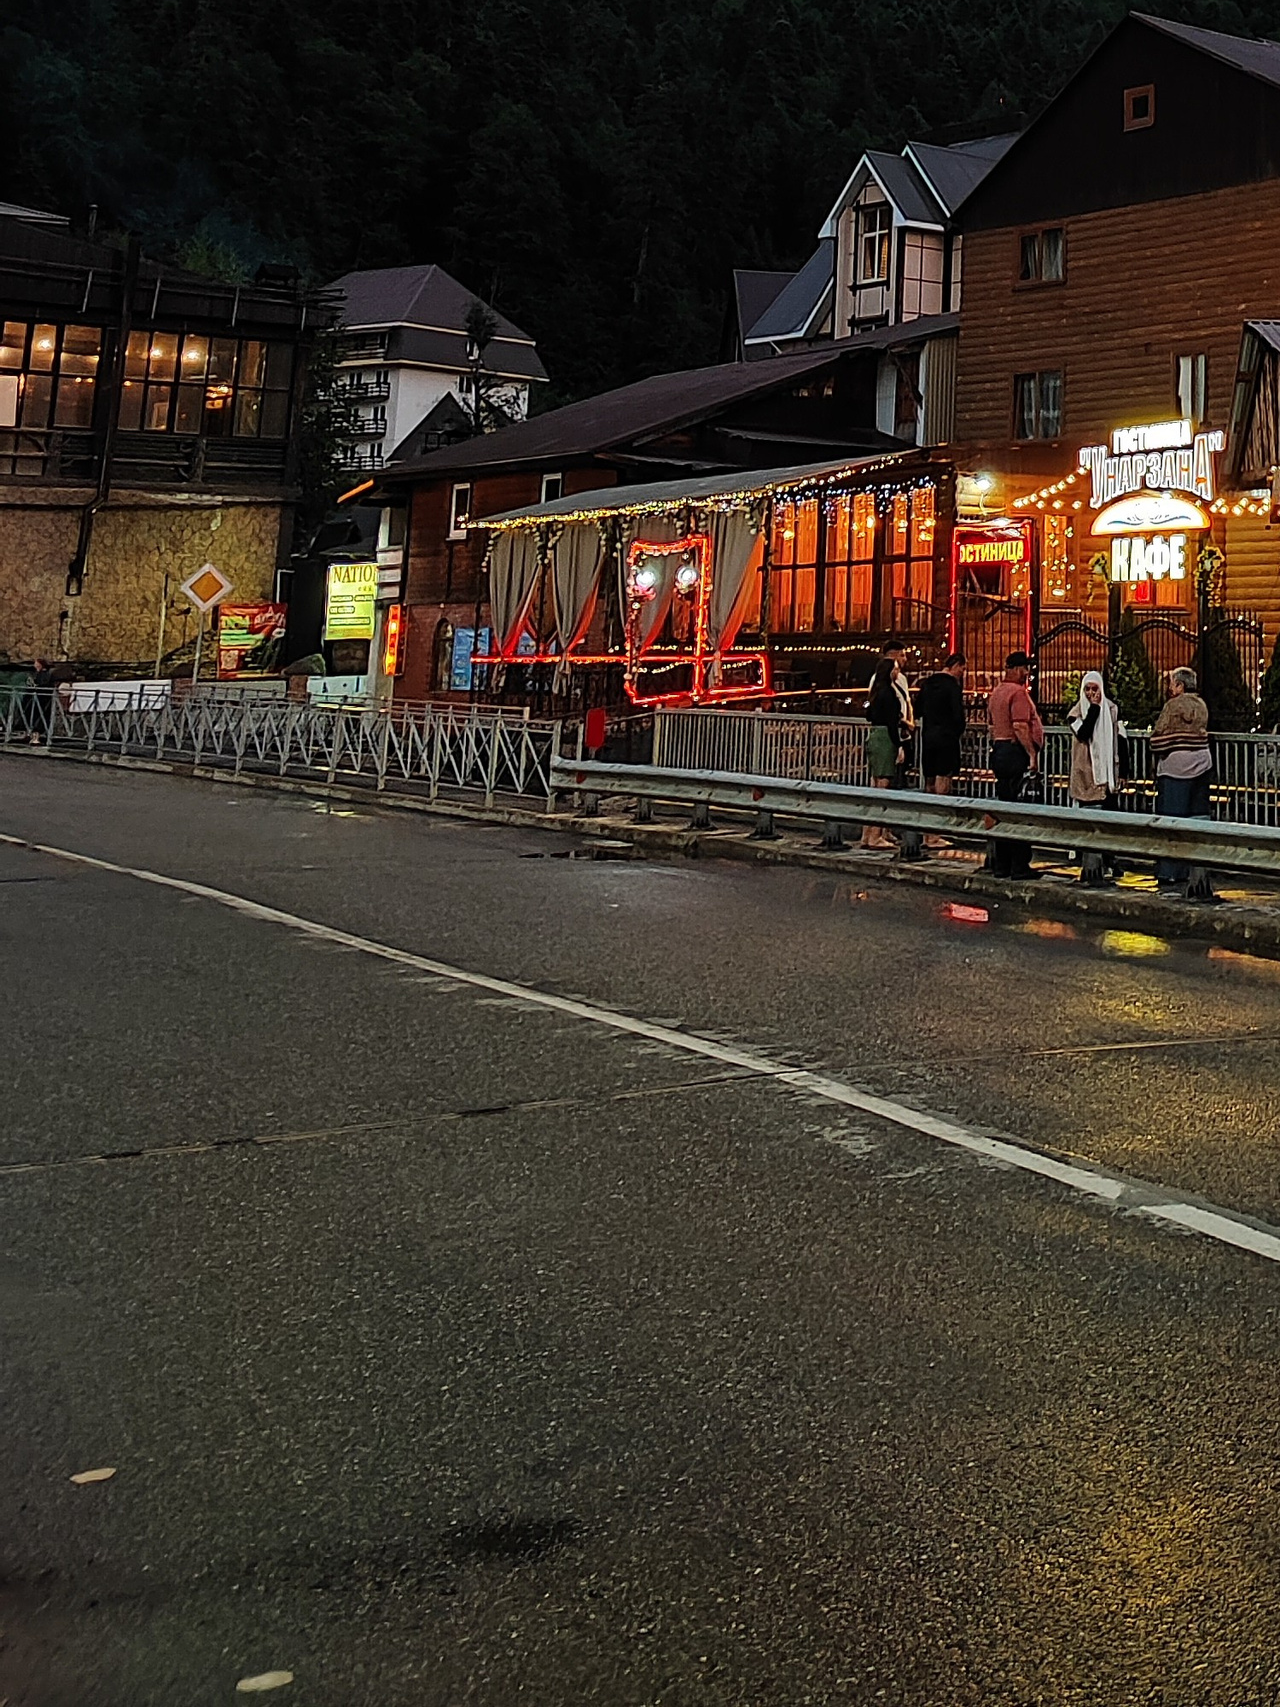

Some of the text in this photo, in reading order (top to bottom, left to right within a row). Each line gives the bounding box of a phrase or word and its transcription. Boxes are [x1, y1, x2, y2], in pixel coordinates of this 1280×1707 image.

[1113, 419, 1192, 454] ГОСТА
[960, 540, 1023, 563] ОСТИНИЦА
[1112, 534, 1186, 581] КАФЕ
